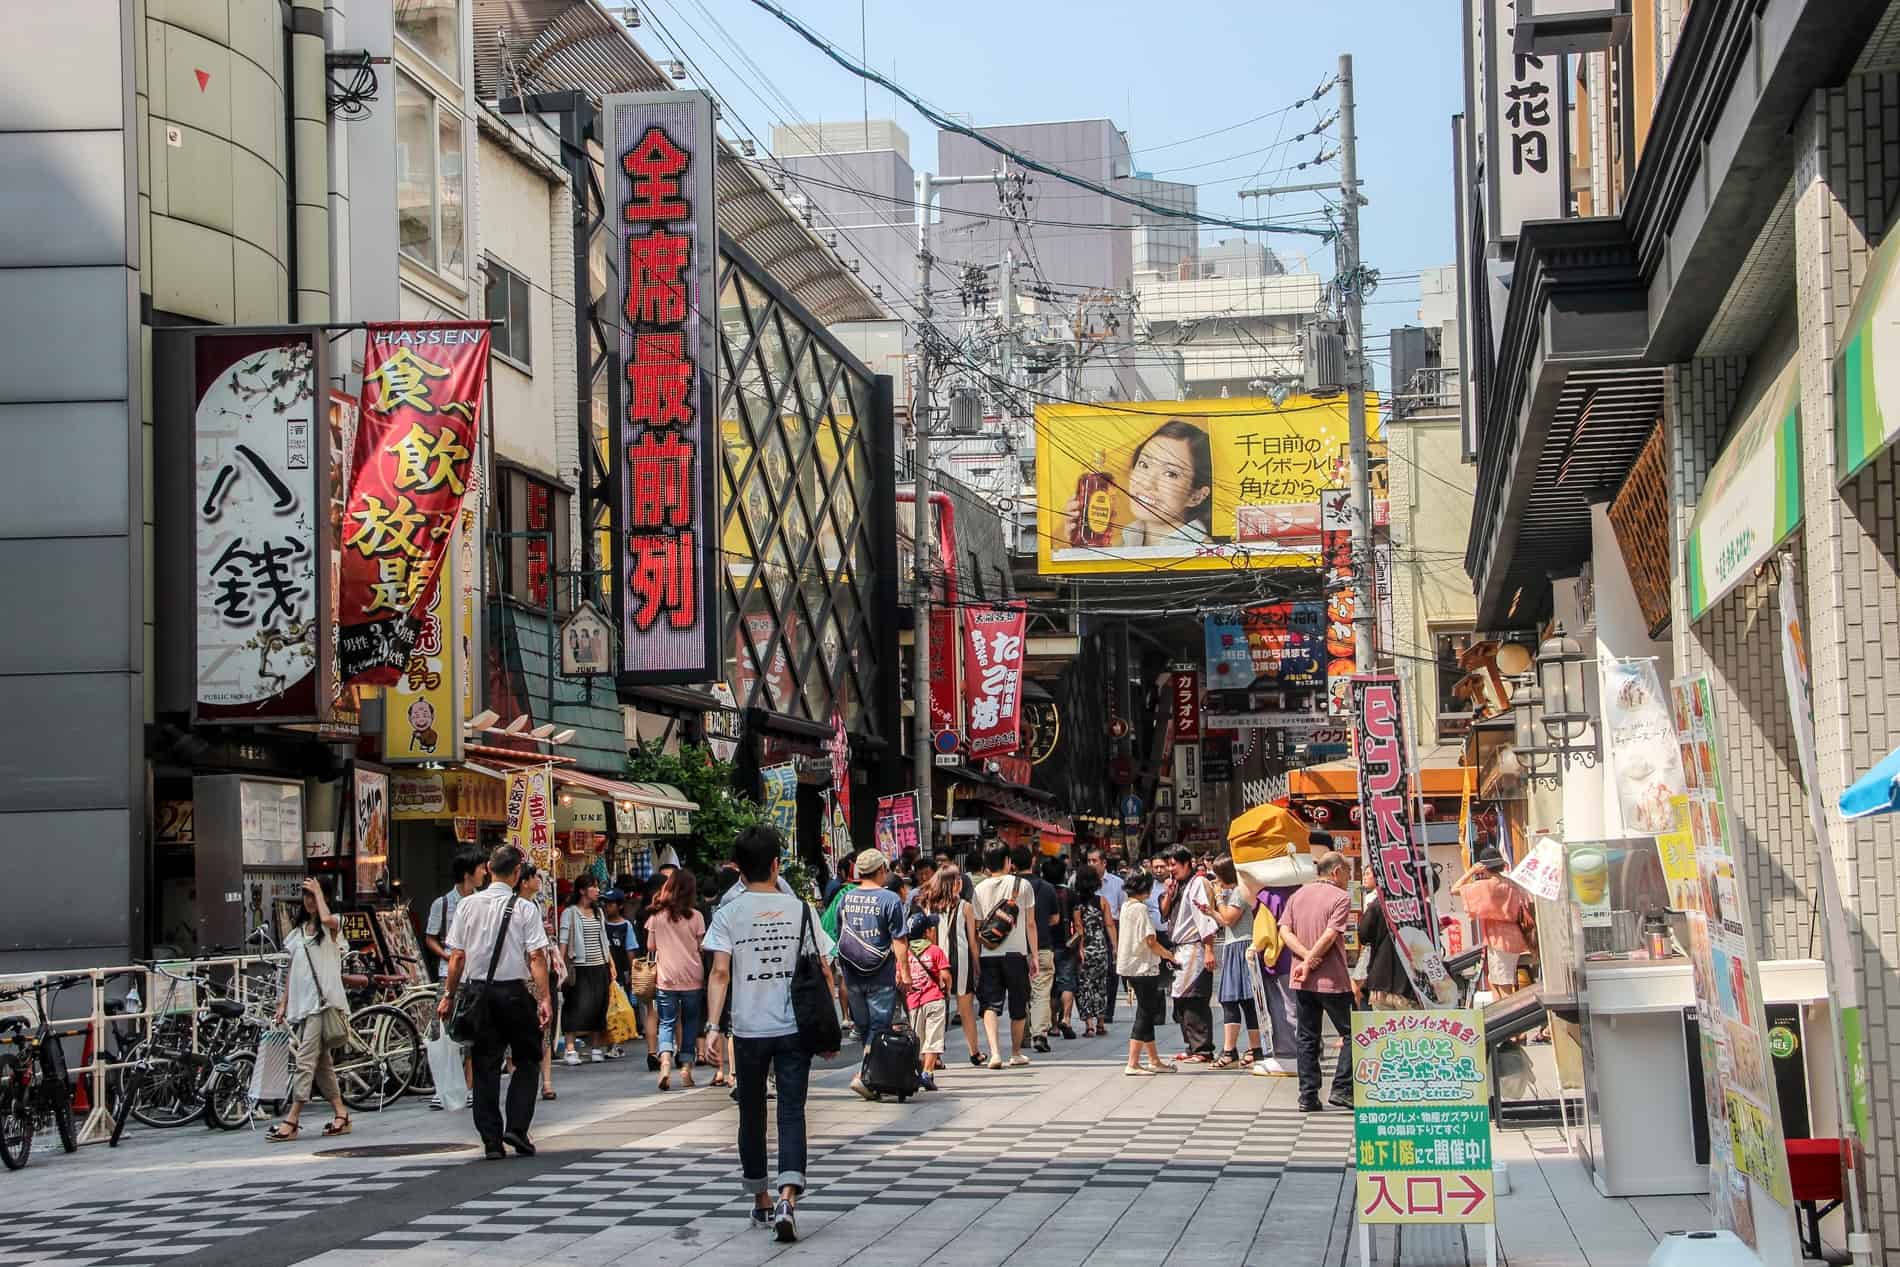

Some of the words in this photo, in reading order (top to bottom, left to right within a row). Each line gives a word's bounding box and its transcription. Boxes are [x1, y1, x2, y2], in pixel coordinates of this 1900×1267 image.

[375, 329, 481, 345] HASSEN
[622, 127, 697, 631] 全席最前列
[1235, 433, 1321, 456] 千日前の
[203, 443, 304, 627] 八銭
[1178, 676, 1194, 731] カラオケ
[572, 813, 603, 822] JUNE
[746, 970, 793, 982] LOSE
[1382, 1039, 1455, 1060] よしもと
[1359, 1139, 1487, 1166] 地下1階にて開催中!
[1364, 1175, 1444, 1216] 入口
